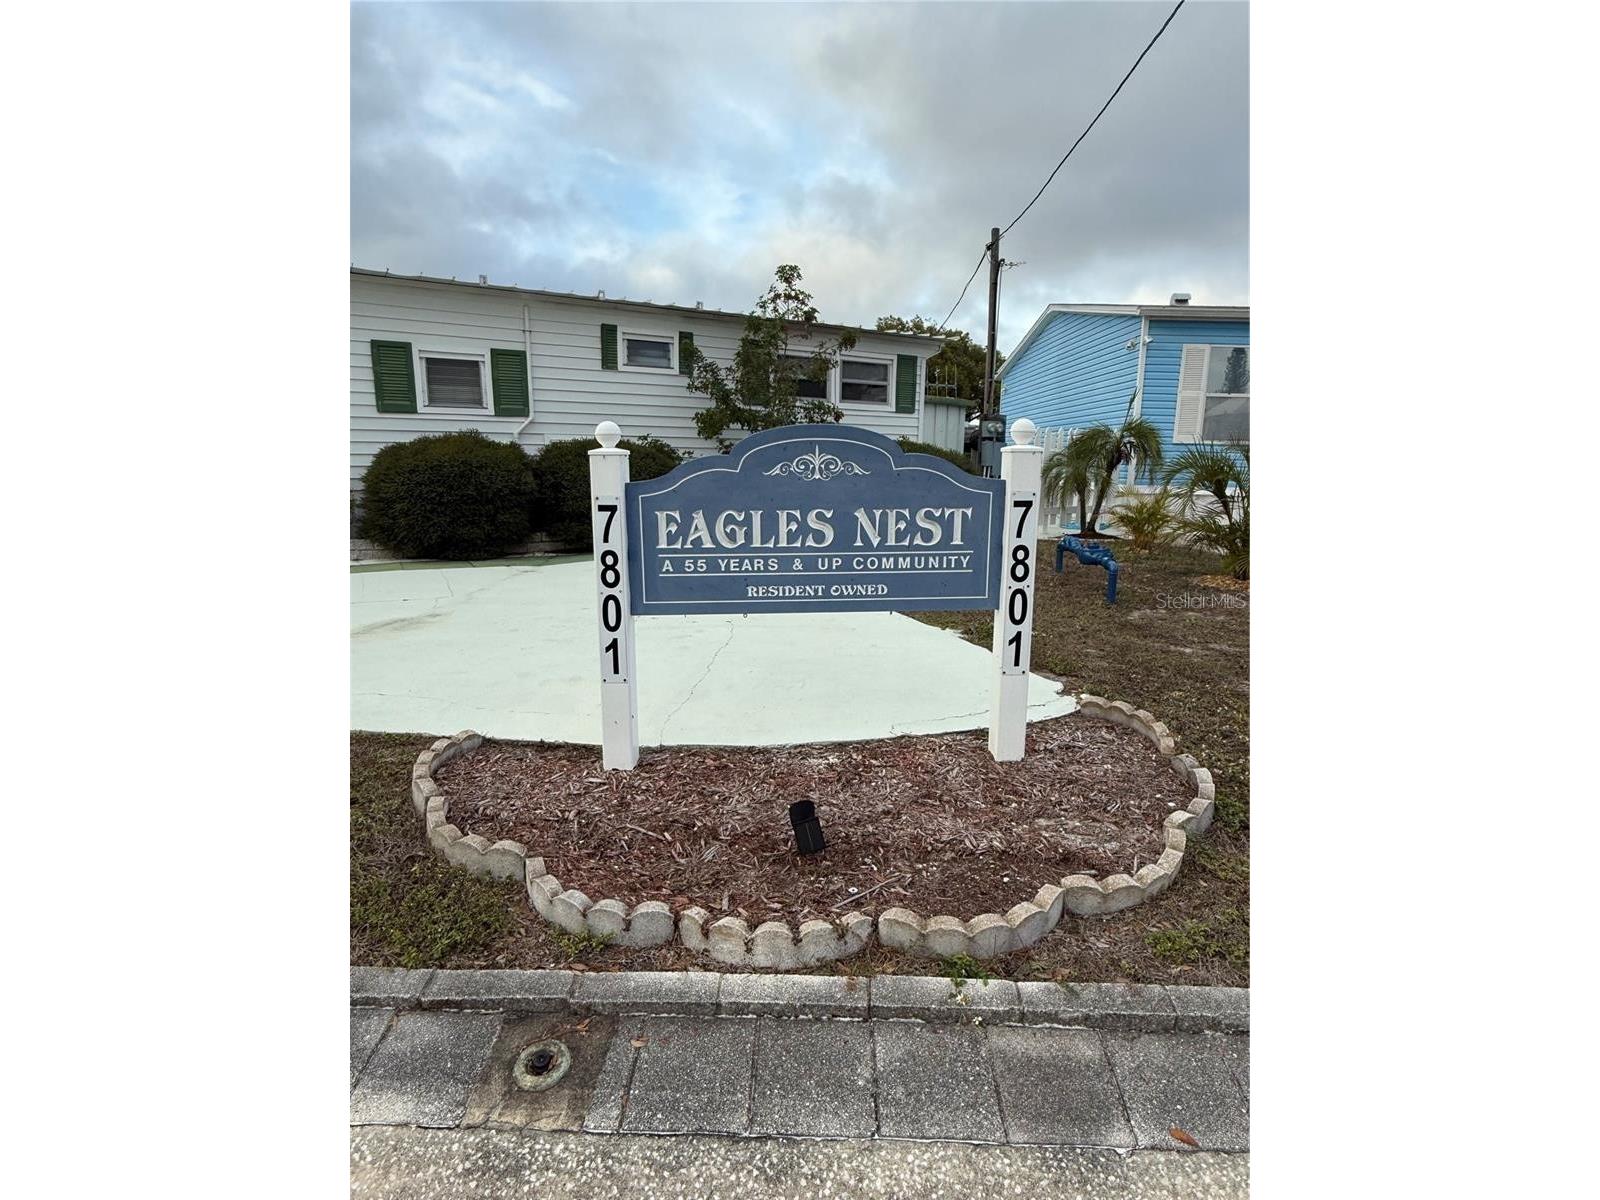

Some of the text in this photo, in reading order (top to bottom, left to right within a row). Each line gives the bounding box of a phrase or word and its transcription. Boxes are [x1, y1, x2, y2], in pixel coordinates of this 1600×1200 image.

[654, 506, 974, 549] EAGLES NEST
[661, 555, 971, 574] A 55 YEARS & UP COMMUNITY
[1008, 500, 1034, 667] 7801
[597, 504, 622, 675] 7801
[746, 583, 888, 598] RESIDENT OWNED
